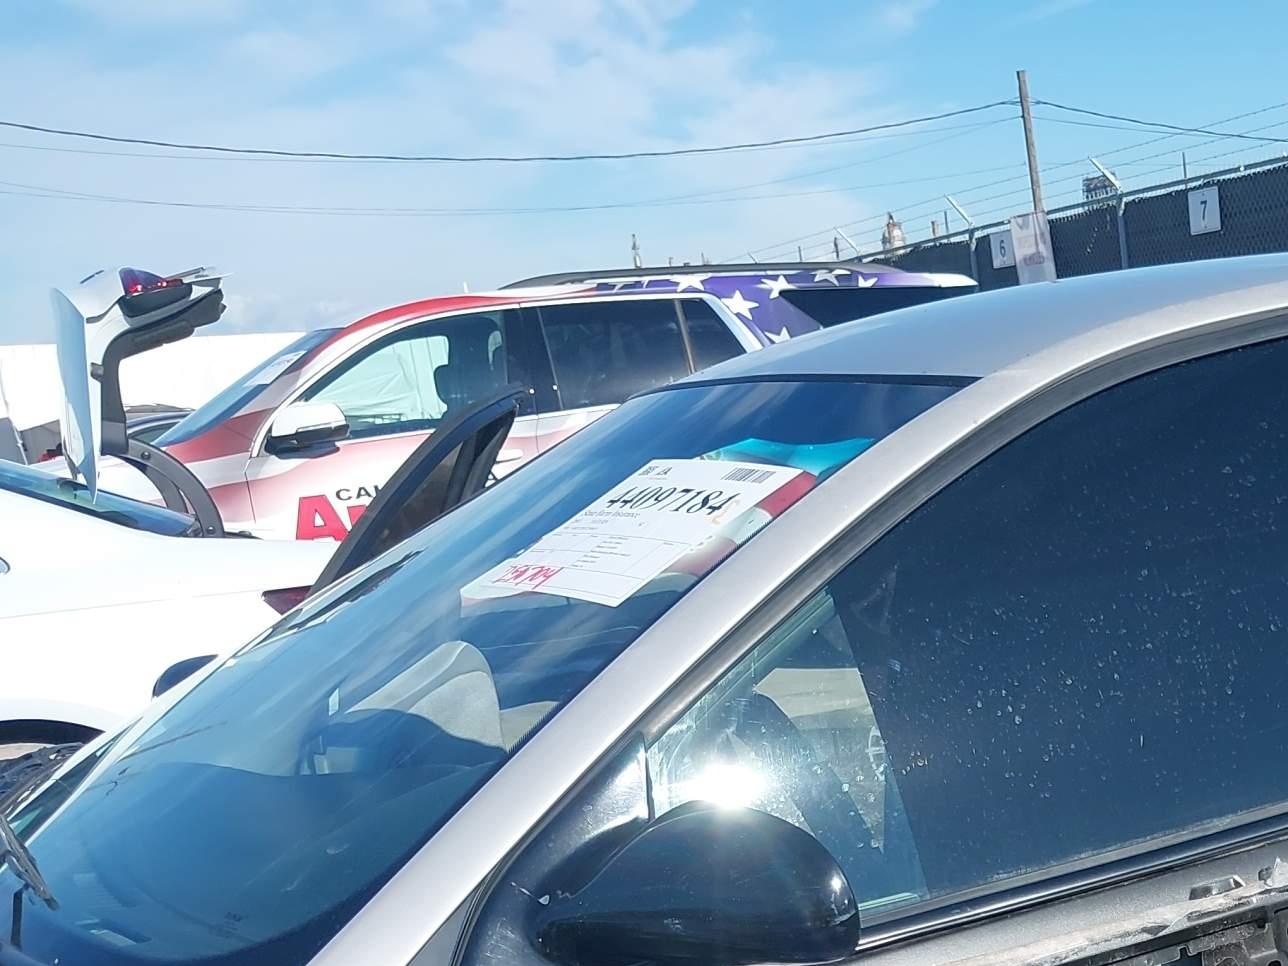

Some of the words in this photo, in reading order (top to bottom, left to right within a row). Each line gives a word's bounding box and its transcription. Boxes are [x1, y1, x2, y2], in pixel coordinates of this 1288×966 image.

[1200, 200, 1208, 221] 7
[999, 239, 1007, 258] 6
[605, 486, 741, 515] 44097184
